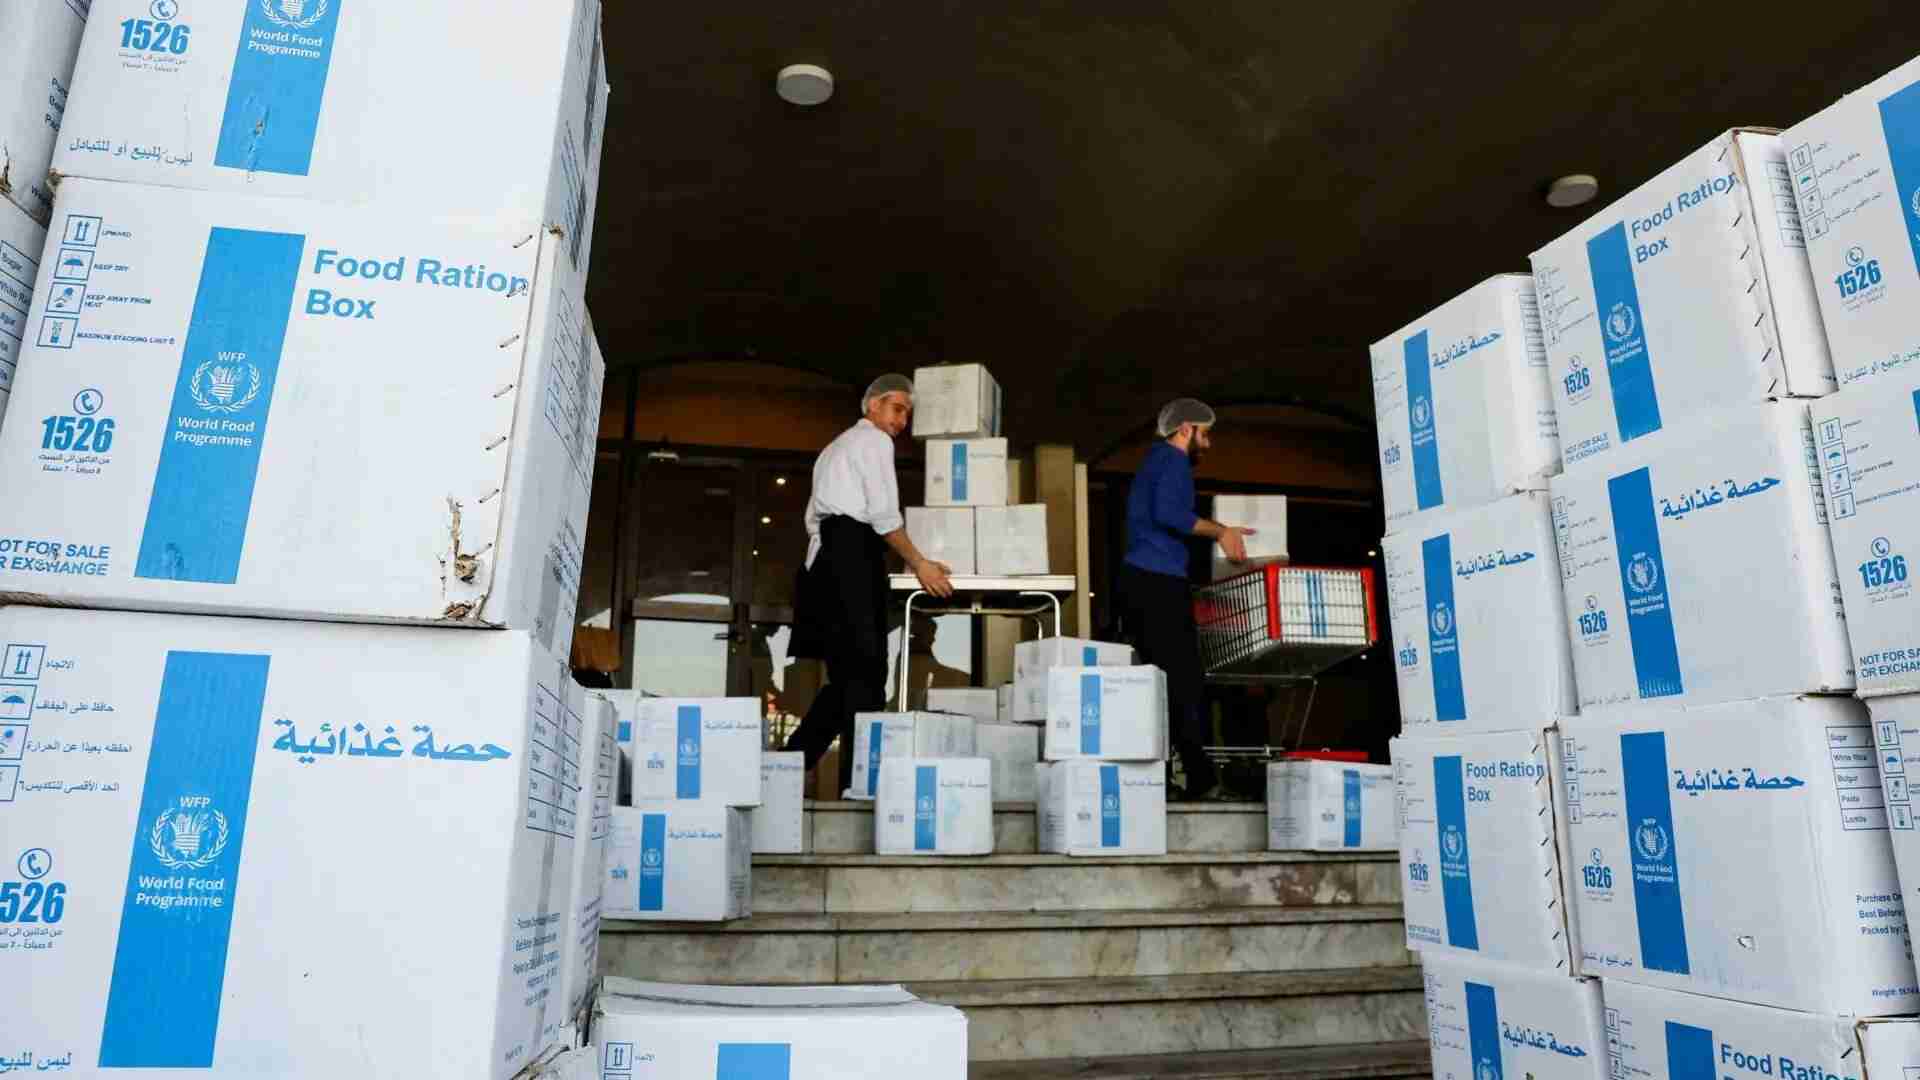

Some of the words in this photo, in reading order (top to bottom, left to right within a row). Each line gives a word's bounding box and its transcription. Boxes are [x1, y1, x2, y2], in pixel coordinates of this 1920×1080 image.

[120, 18, 192, 54] 1526
[250, 28, 289, 42] World
[292, 33, 323, 47] Food
[247, 40, 321, 58] Programme
[1631, 203, 1674, 240] Food
[1677, 171, 1741, 213] Ration
[1634, 237, 1669, 264] Box
[313, 248, 406, 282] Food
[415, 258, 529, 297] Ration
[1834, 259, 1882, 298] 1526
[304, 288, 377, 319] Box
[1469, 332, 1502, 351] حصة
[217, 351, 246, 362] WFP
[1563, 367, 1591, 395] 1526
[41, 415, 115, 453] 1526
[177, 416, 218, 430] World
[221, 419, 256, 433] Food
[174, 430, 253, 448] Programme
[1724, 477, 1781, 499] حصة
[1660, 485, 1724, 521] غذائية
[0, 539, 22, 553] OT
[24, 540, 62, 558] FOR
[65, 543, 110, 559] SALE
[1496, 549, 1536, 567] حصة
[11, 557, 109, 576] EXCHANGE
[1456, 555, 1497, 580] غذائية
[1858, 555, 1907, 588] 1526
[1578, 610, 1608, 636] 1526
[1859, 654, 1881, 666] NOT
[1881, 650, 1905, 662] FOR
[1879, 660, 1920, 675] EXCHAN
[272, 718, 404, 765] غذائية
[412, 724, 512, 762] حصة
[1466, 762, 1496, 778] Food
[1499, 761, 1545, 778] Ration
[1742, 768, 1806, 790] حصة
[1673, 768, 1741, 796] غذائية
[179, 796, 211, 808] WFP
[1467, 786, 1491, 802] Box
[138, 876, 184, 889] World
[187, 878, 225, 890] Food
[1582, 865, 1613, 889] 1526
[0, 882, 66, 923] 526
[135, 892, 223, 909] Programme
[1858, 909, 1876, 919] Best
[1861, 926, 1889, 935] Packed
[1502, 1020, 1548, 1049] غذائية
[1548, 1032, 1588, 1057] حصة
[36, 1051, 72, 1070] ليس
[1719, 1043, 1773, 1075] Food
